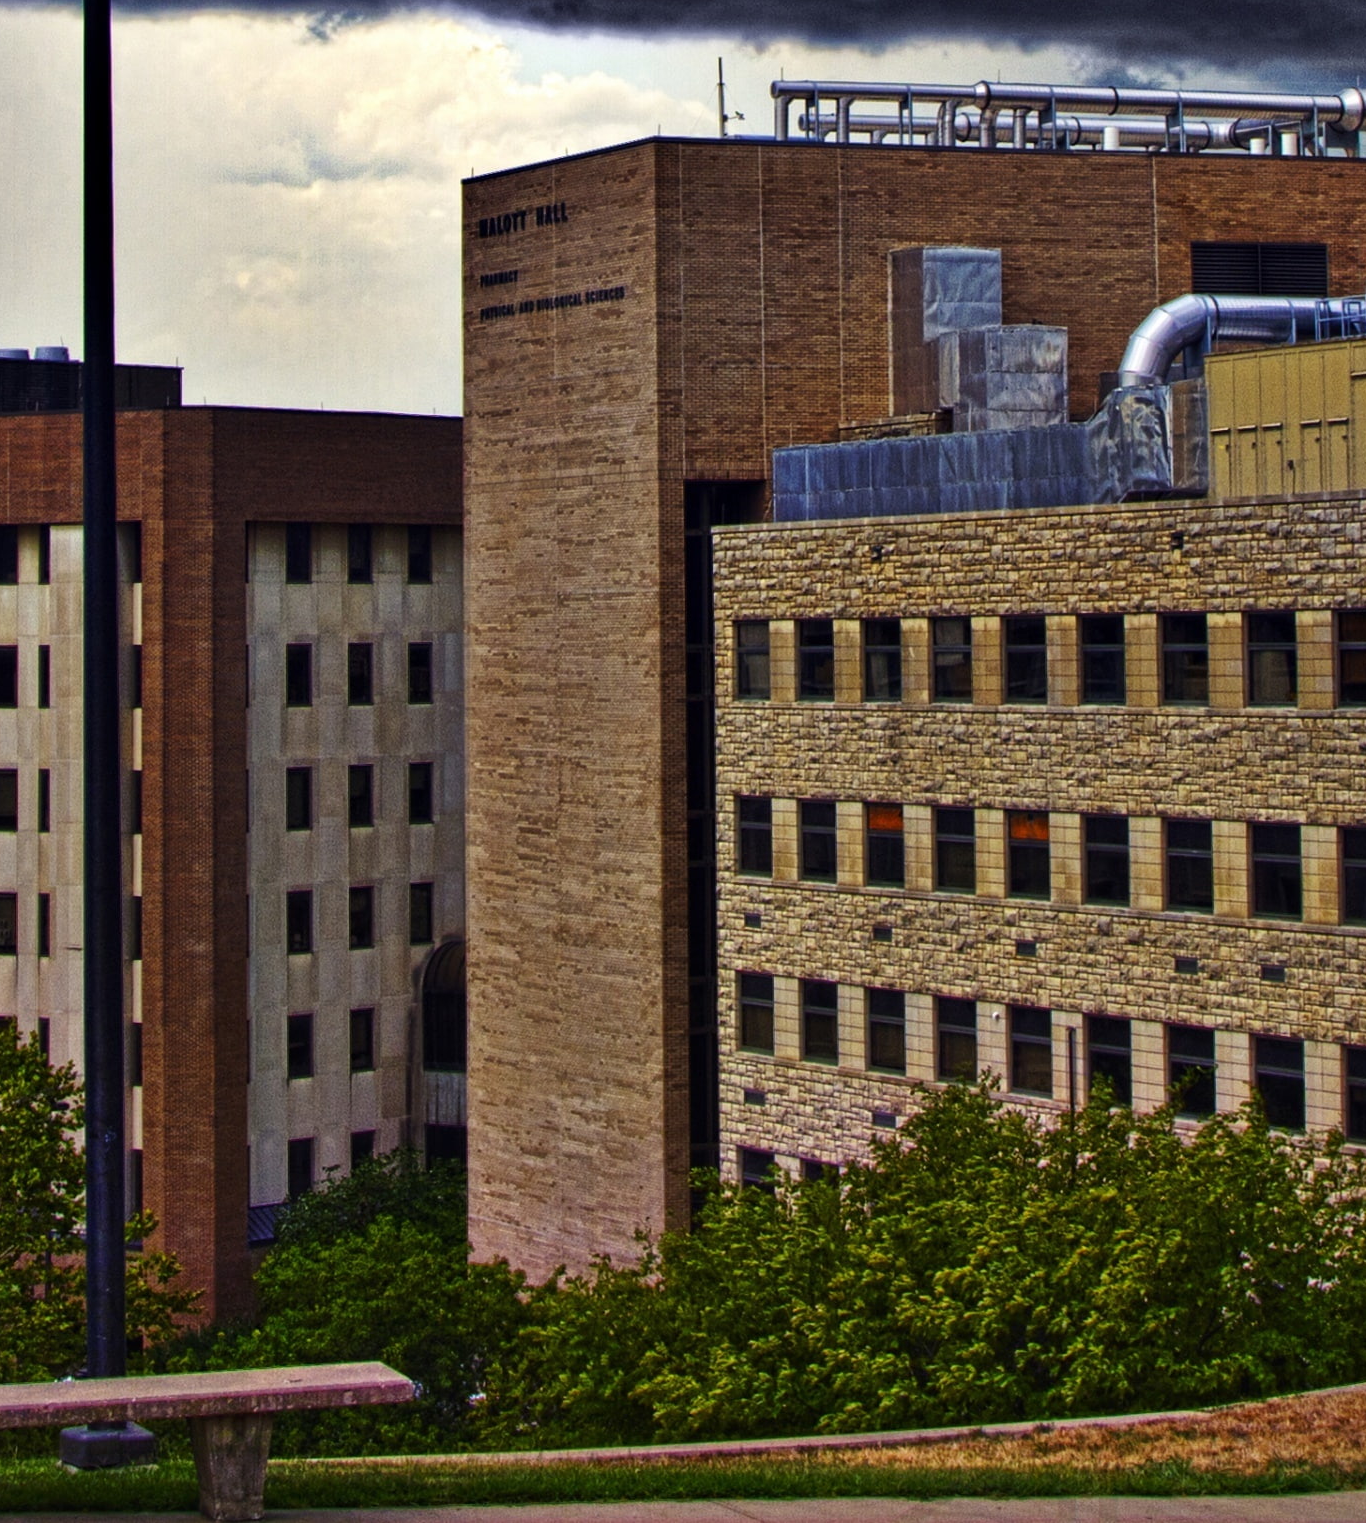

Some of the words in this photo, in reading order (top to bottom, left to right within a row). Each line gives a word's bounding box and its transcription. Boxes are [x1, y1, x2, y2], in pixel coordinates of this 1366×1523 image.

[479, 210, 526, 238] MALOTT
[536, 203, 568, 227] HALL
[480, 270, 518, 287] PHARMACY
[519, 301, 534, 314] AND
[536, 293, 582, 311] BIOLOGICAL
[585, 286, 625, 304] SCIENCES
